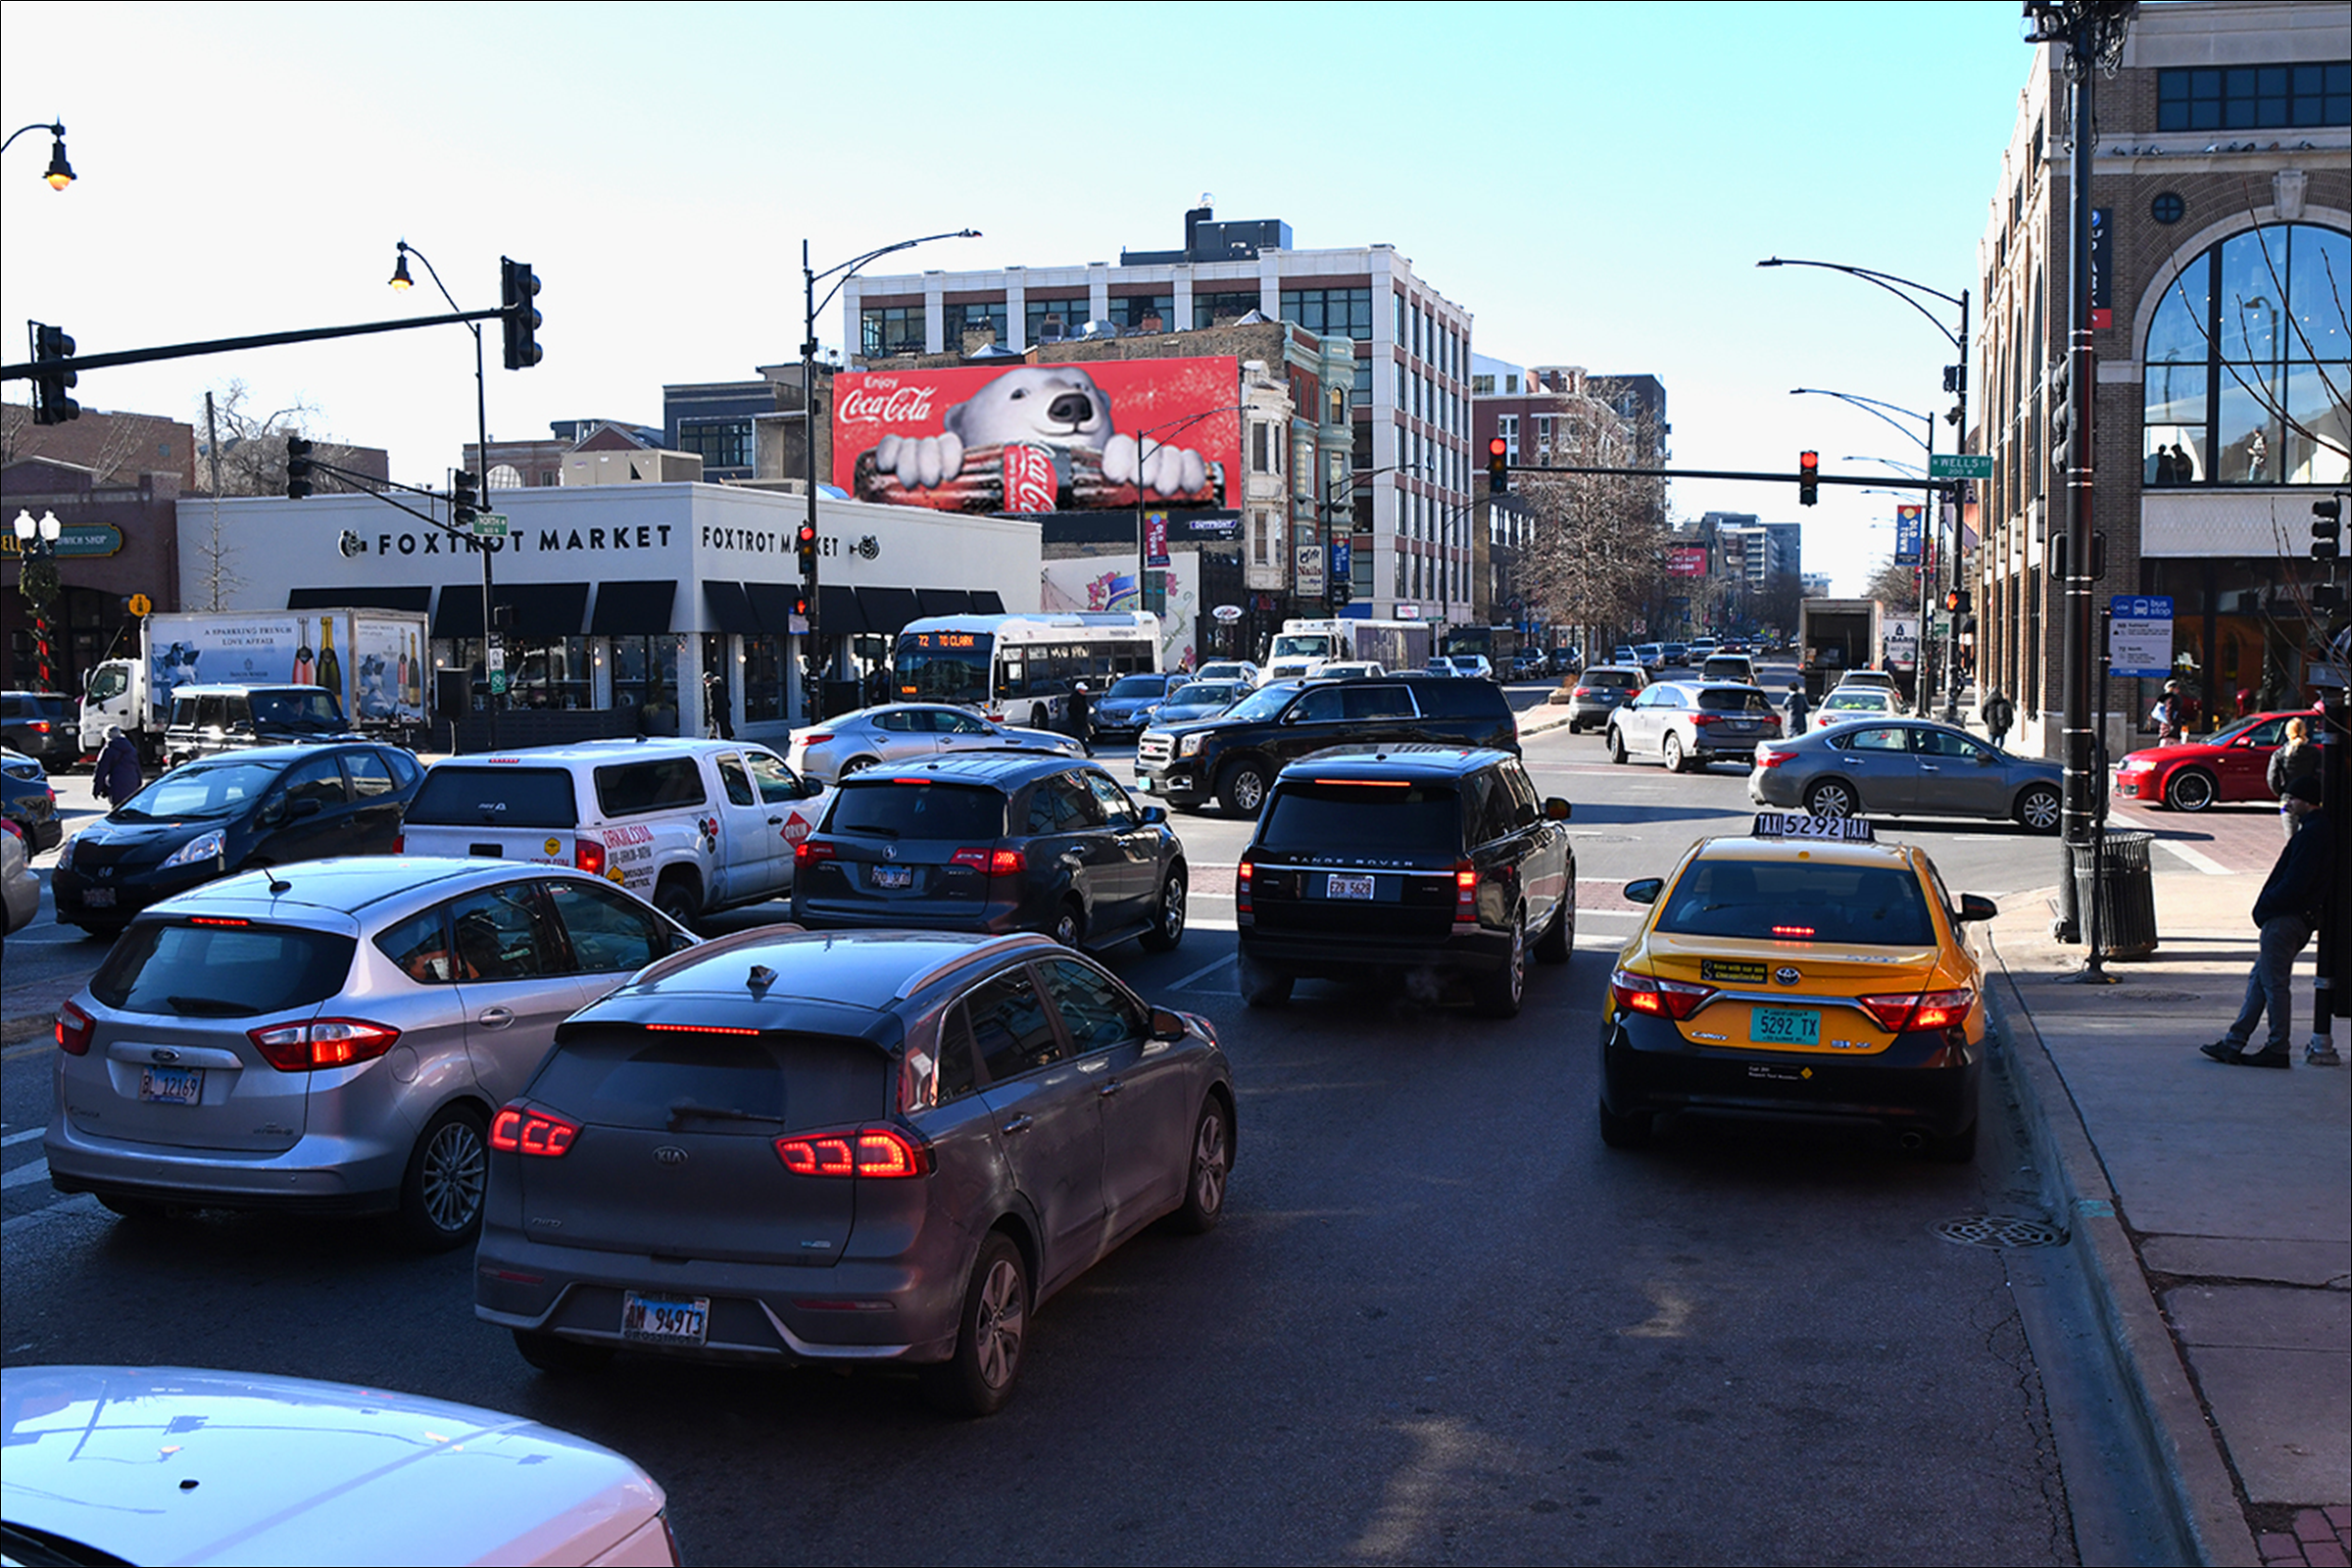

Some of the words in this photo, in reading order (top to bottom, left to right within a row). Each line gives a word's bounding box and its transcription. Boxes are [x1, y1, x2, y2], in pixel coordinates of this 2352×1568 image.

[864, 376, 899, 389] Enjoy
[1940, 458, 1980, 468] WELLS
[378, 530, 524, 556] FOXTROT
[539, 524, 672, 552] MARKET
[702, 526, 775, 553] FOXTROT
[2150, 599, 2168, 608] bus
[2150, 609, 2172, 617] stop
[918, 634, 929, 647] 72
[950, 634, 975, 647] CLARK
[1758, 815, 1782, 834] TAXI
[1785, 815, 1839, 837] 5292
[1846, 819, 1870, 839] TAXI
[1290, 856, 1344, 864] RANGE
[1356, 858, 1413, 867] ROVER
[1761, 1015, 1793, 1036] 5292
[1801, 1018, 1817, 1037] TX
[163, 1077, 198, 1097] 12169
[657, 1151, 681, 1162] KIA
[655, 1307, 704, 1335] 94973
